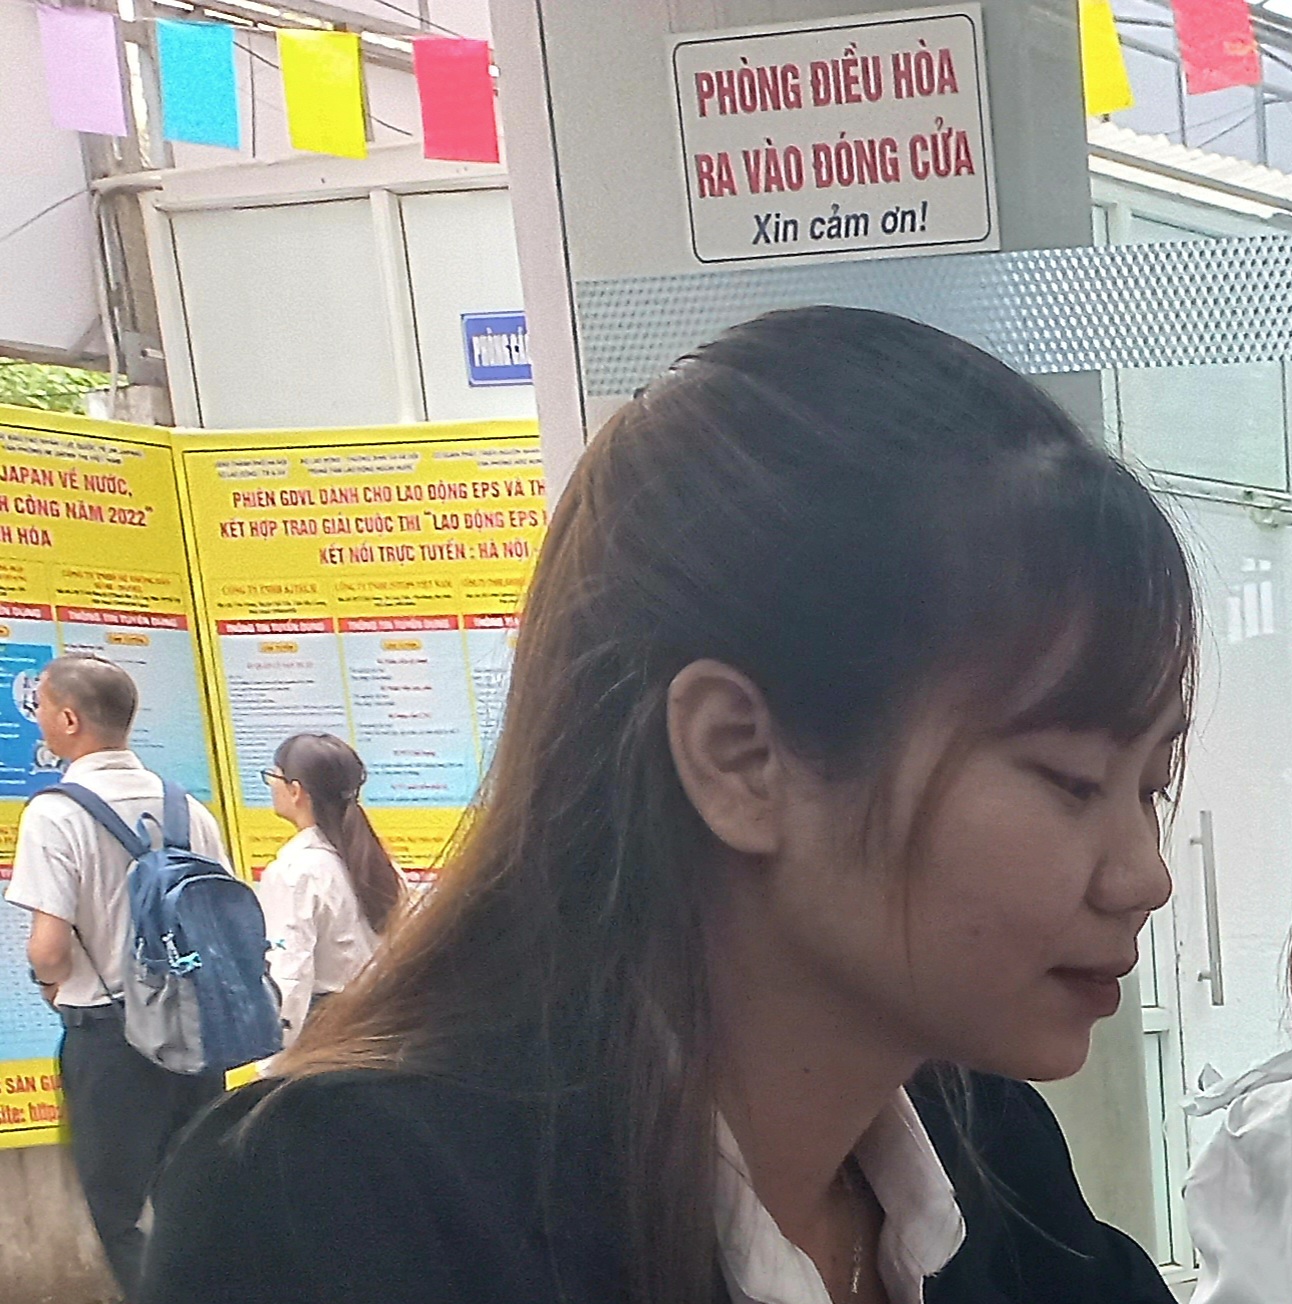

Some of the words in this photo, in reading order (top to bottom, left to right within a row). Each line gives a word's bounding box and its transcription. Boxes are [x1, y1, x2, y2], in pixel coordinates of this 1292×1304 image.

[695, 57, 802, 118] PHÒNG
[810, 42, 883, 107] ĐIỀU
[892, 39, 959, 99] HÒA
[695, 152, 738, 199] RA
[743, 137, 804, 195] VÀO
[812, 132, 900, 189] ĐÓNG
[909, 116, 976, 181] CỬA
[752, 213, 798, 246] Xin
[810, 203, 869, 240] cảm
[881, 201, 928, 235] ơn!
[0, 465, 54, 487] JAPAN
[363, 486, 392, 503] CHO
[396, 484, 423, 501] LAO
[472, 481, 500, 498] EPS
[282, 519, 317, 537] TRAO
